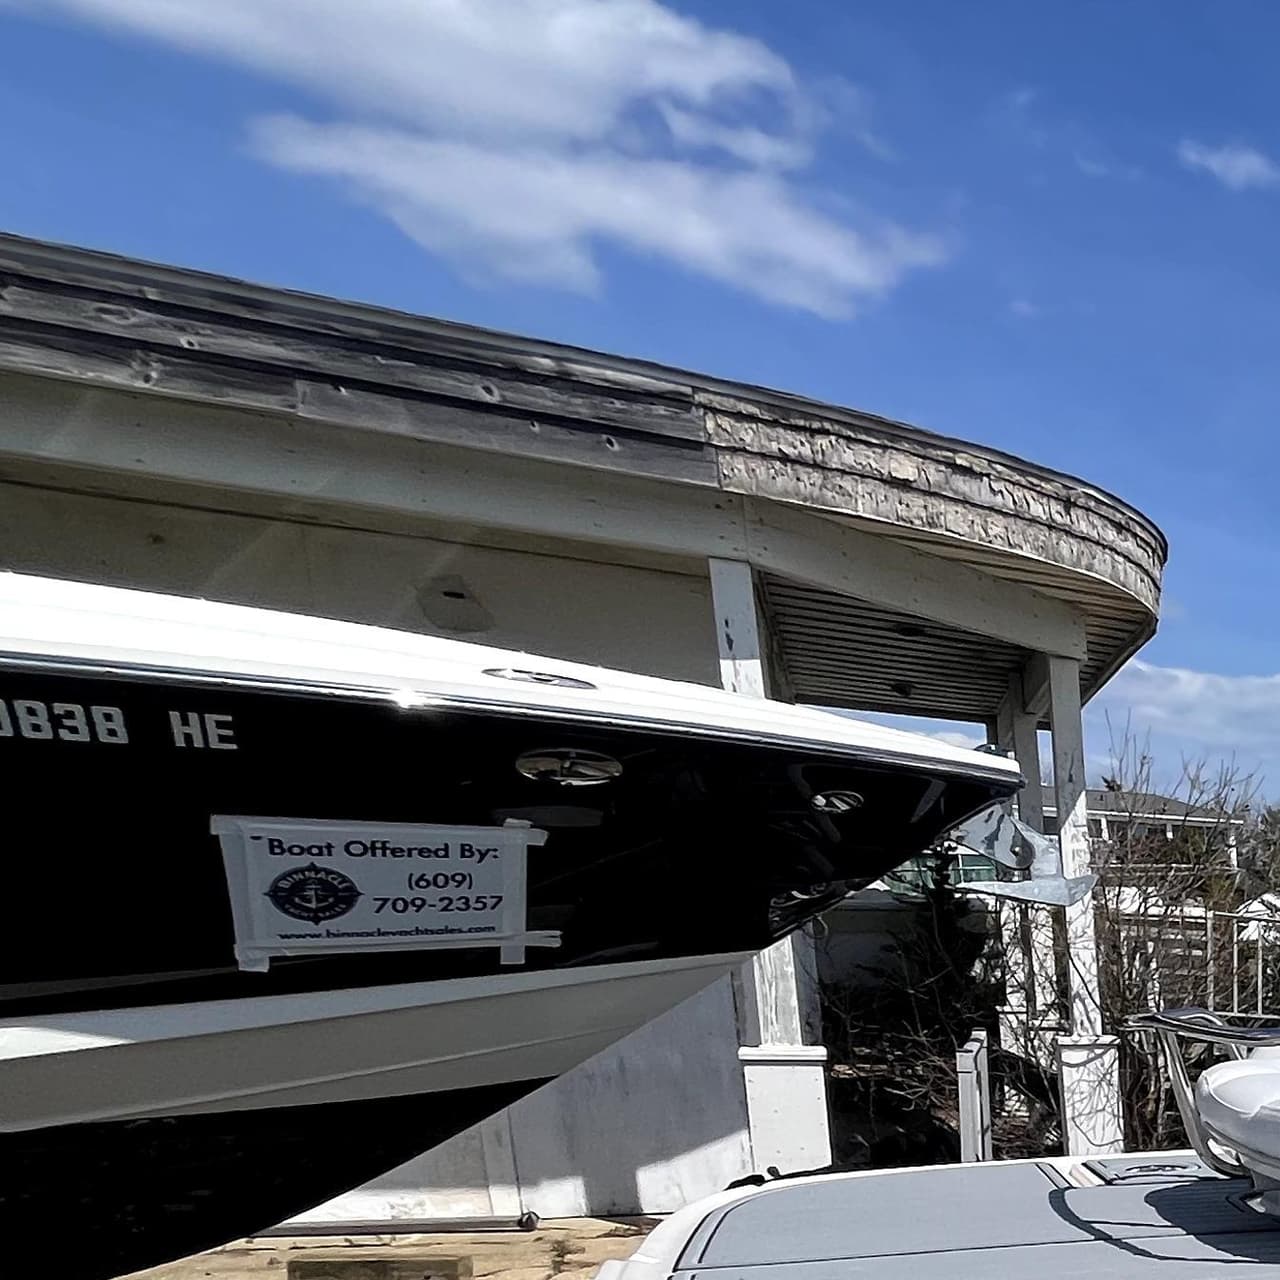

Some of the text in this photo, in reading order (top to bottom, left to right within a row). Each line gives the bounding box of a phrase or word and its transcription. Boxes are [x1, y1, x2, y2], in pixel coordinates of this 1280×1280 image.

[168, 710, 239, 750] HE
[267, 837, 500, 864] Boat Offered By:
[407, 872, 474, 891] (609)
[372, 895, 504, 914] 709-2357
